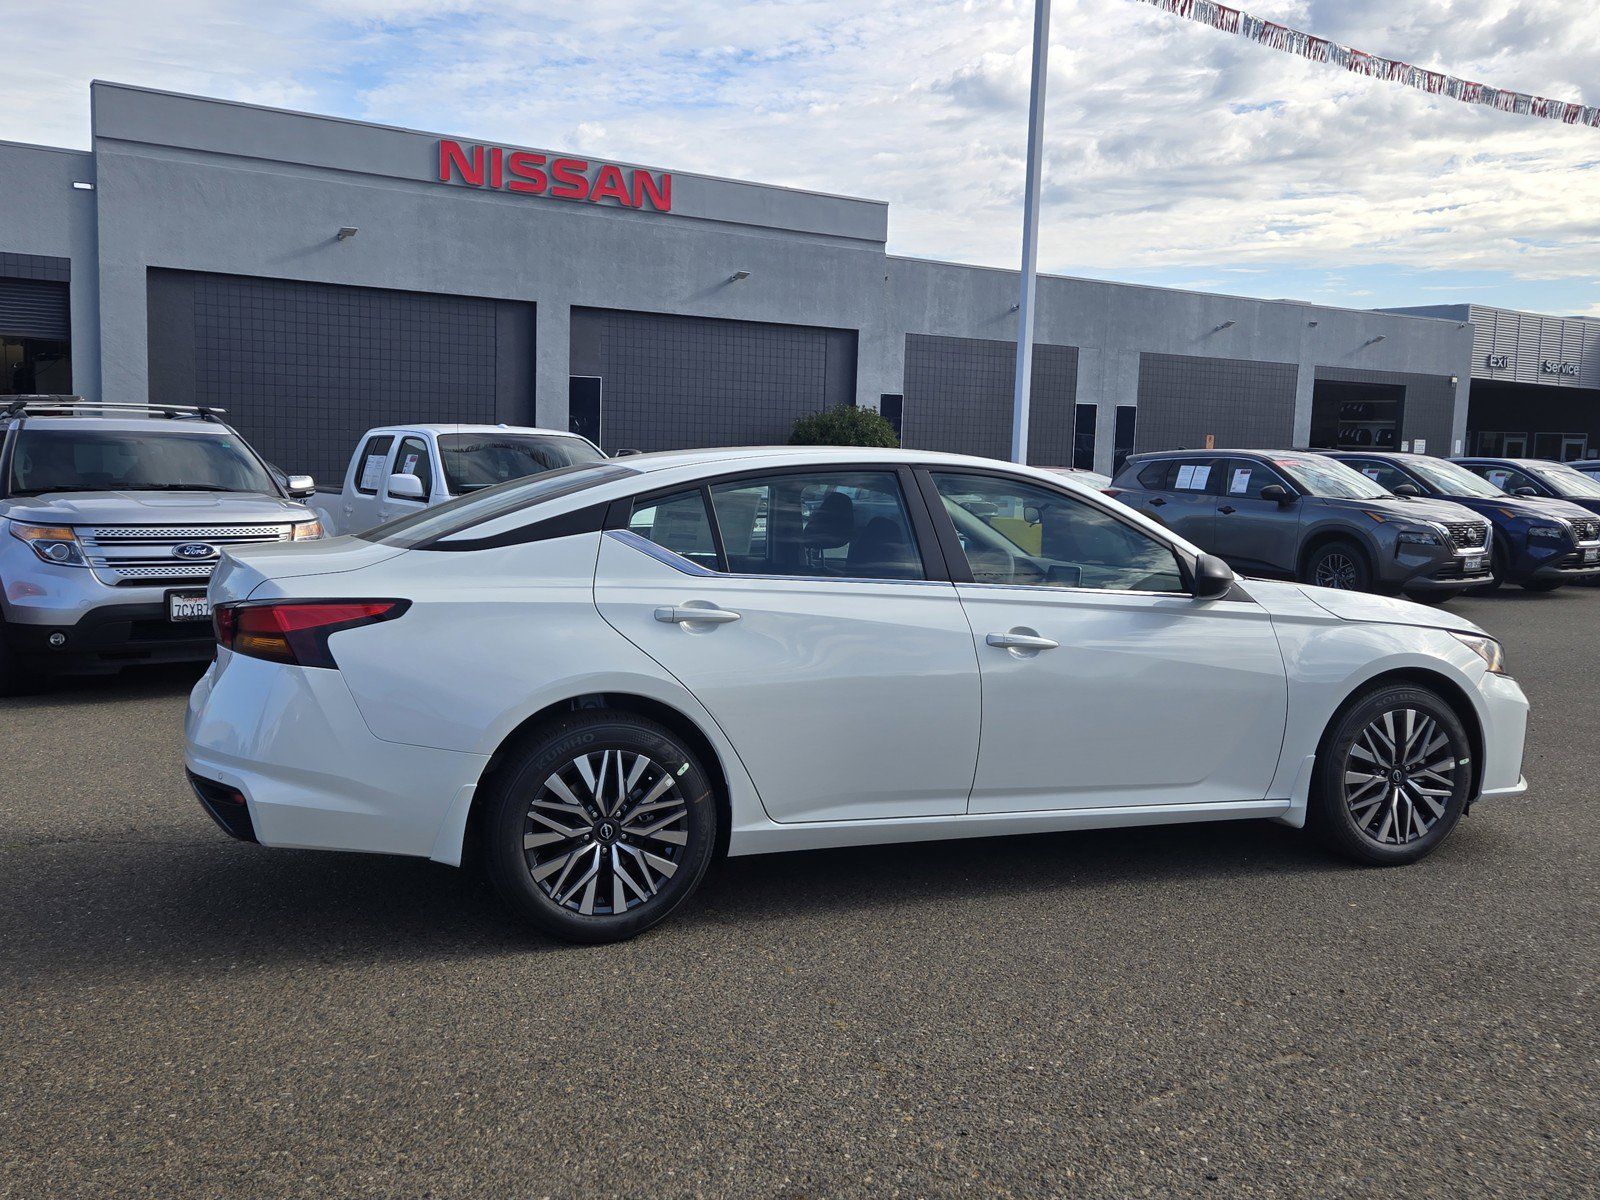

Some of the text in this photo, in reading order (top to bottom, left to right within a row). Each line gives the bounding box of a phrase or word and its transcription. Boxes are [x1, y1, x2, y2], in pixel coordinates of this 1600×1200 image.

[438, 139, 672, 212] NISSAN
[1489, 354, 1510, 368] Exit
[1545, 359, 1580, 375] Service
[184, 545, 207, 555] Ford
[1375, 693, 1417, 707] SOLUS
[537, 732, 596, 769] KUMHO
